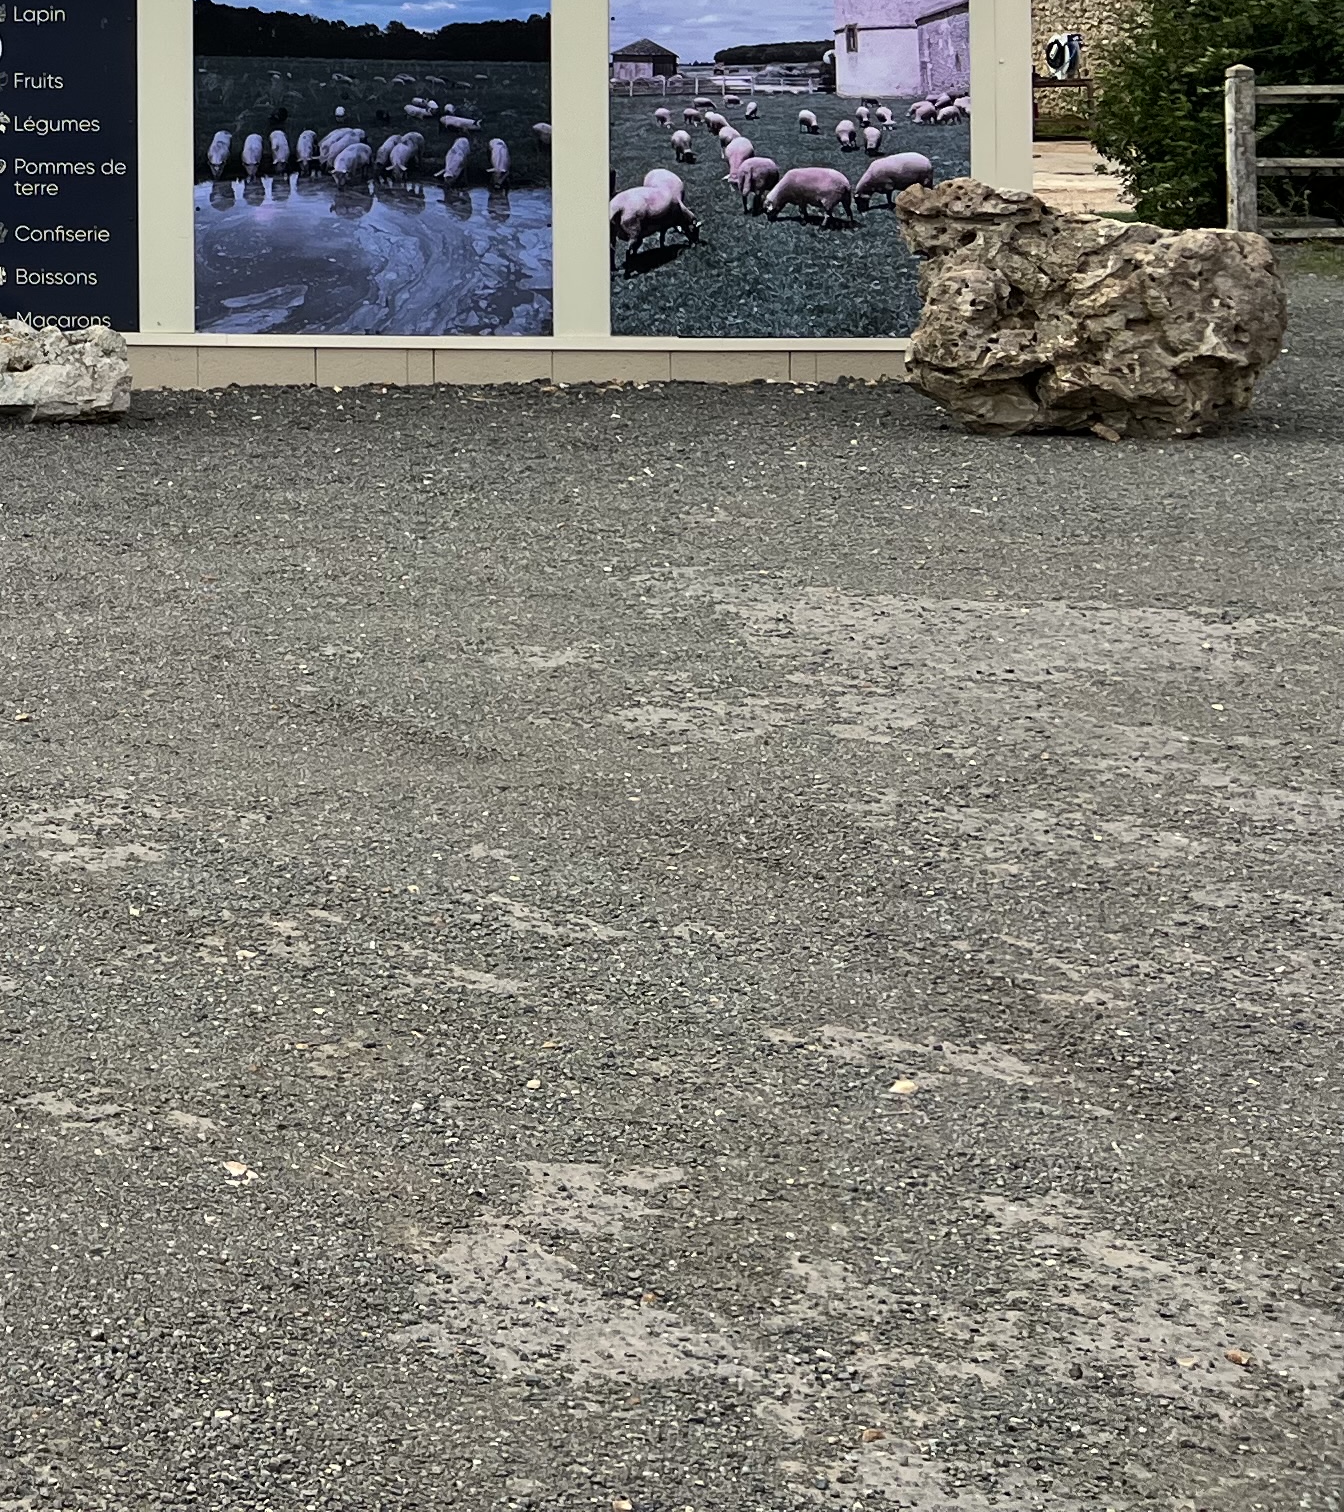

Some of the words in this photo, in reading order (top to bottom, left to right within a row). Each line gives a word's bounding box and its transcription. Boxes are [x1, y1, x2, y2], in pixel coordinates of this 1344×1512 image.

[14, 6, 65, 25] Lapin
[14, 73, 63, 88] Fruits
[15, 116, 100, 135] Légumes
[15, 158, 95, 174] Pommes
[101, 159, 126, 175] de
[14, 181, 58, 195] terre
[15, 225, 110, 242] Confiserie
[16, 268, 97, 285] Boissons
[16, 311, 111, 328] Macarons
